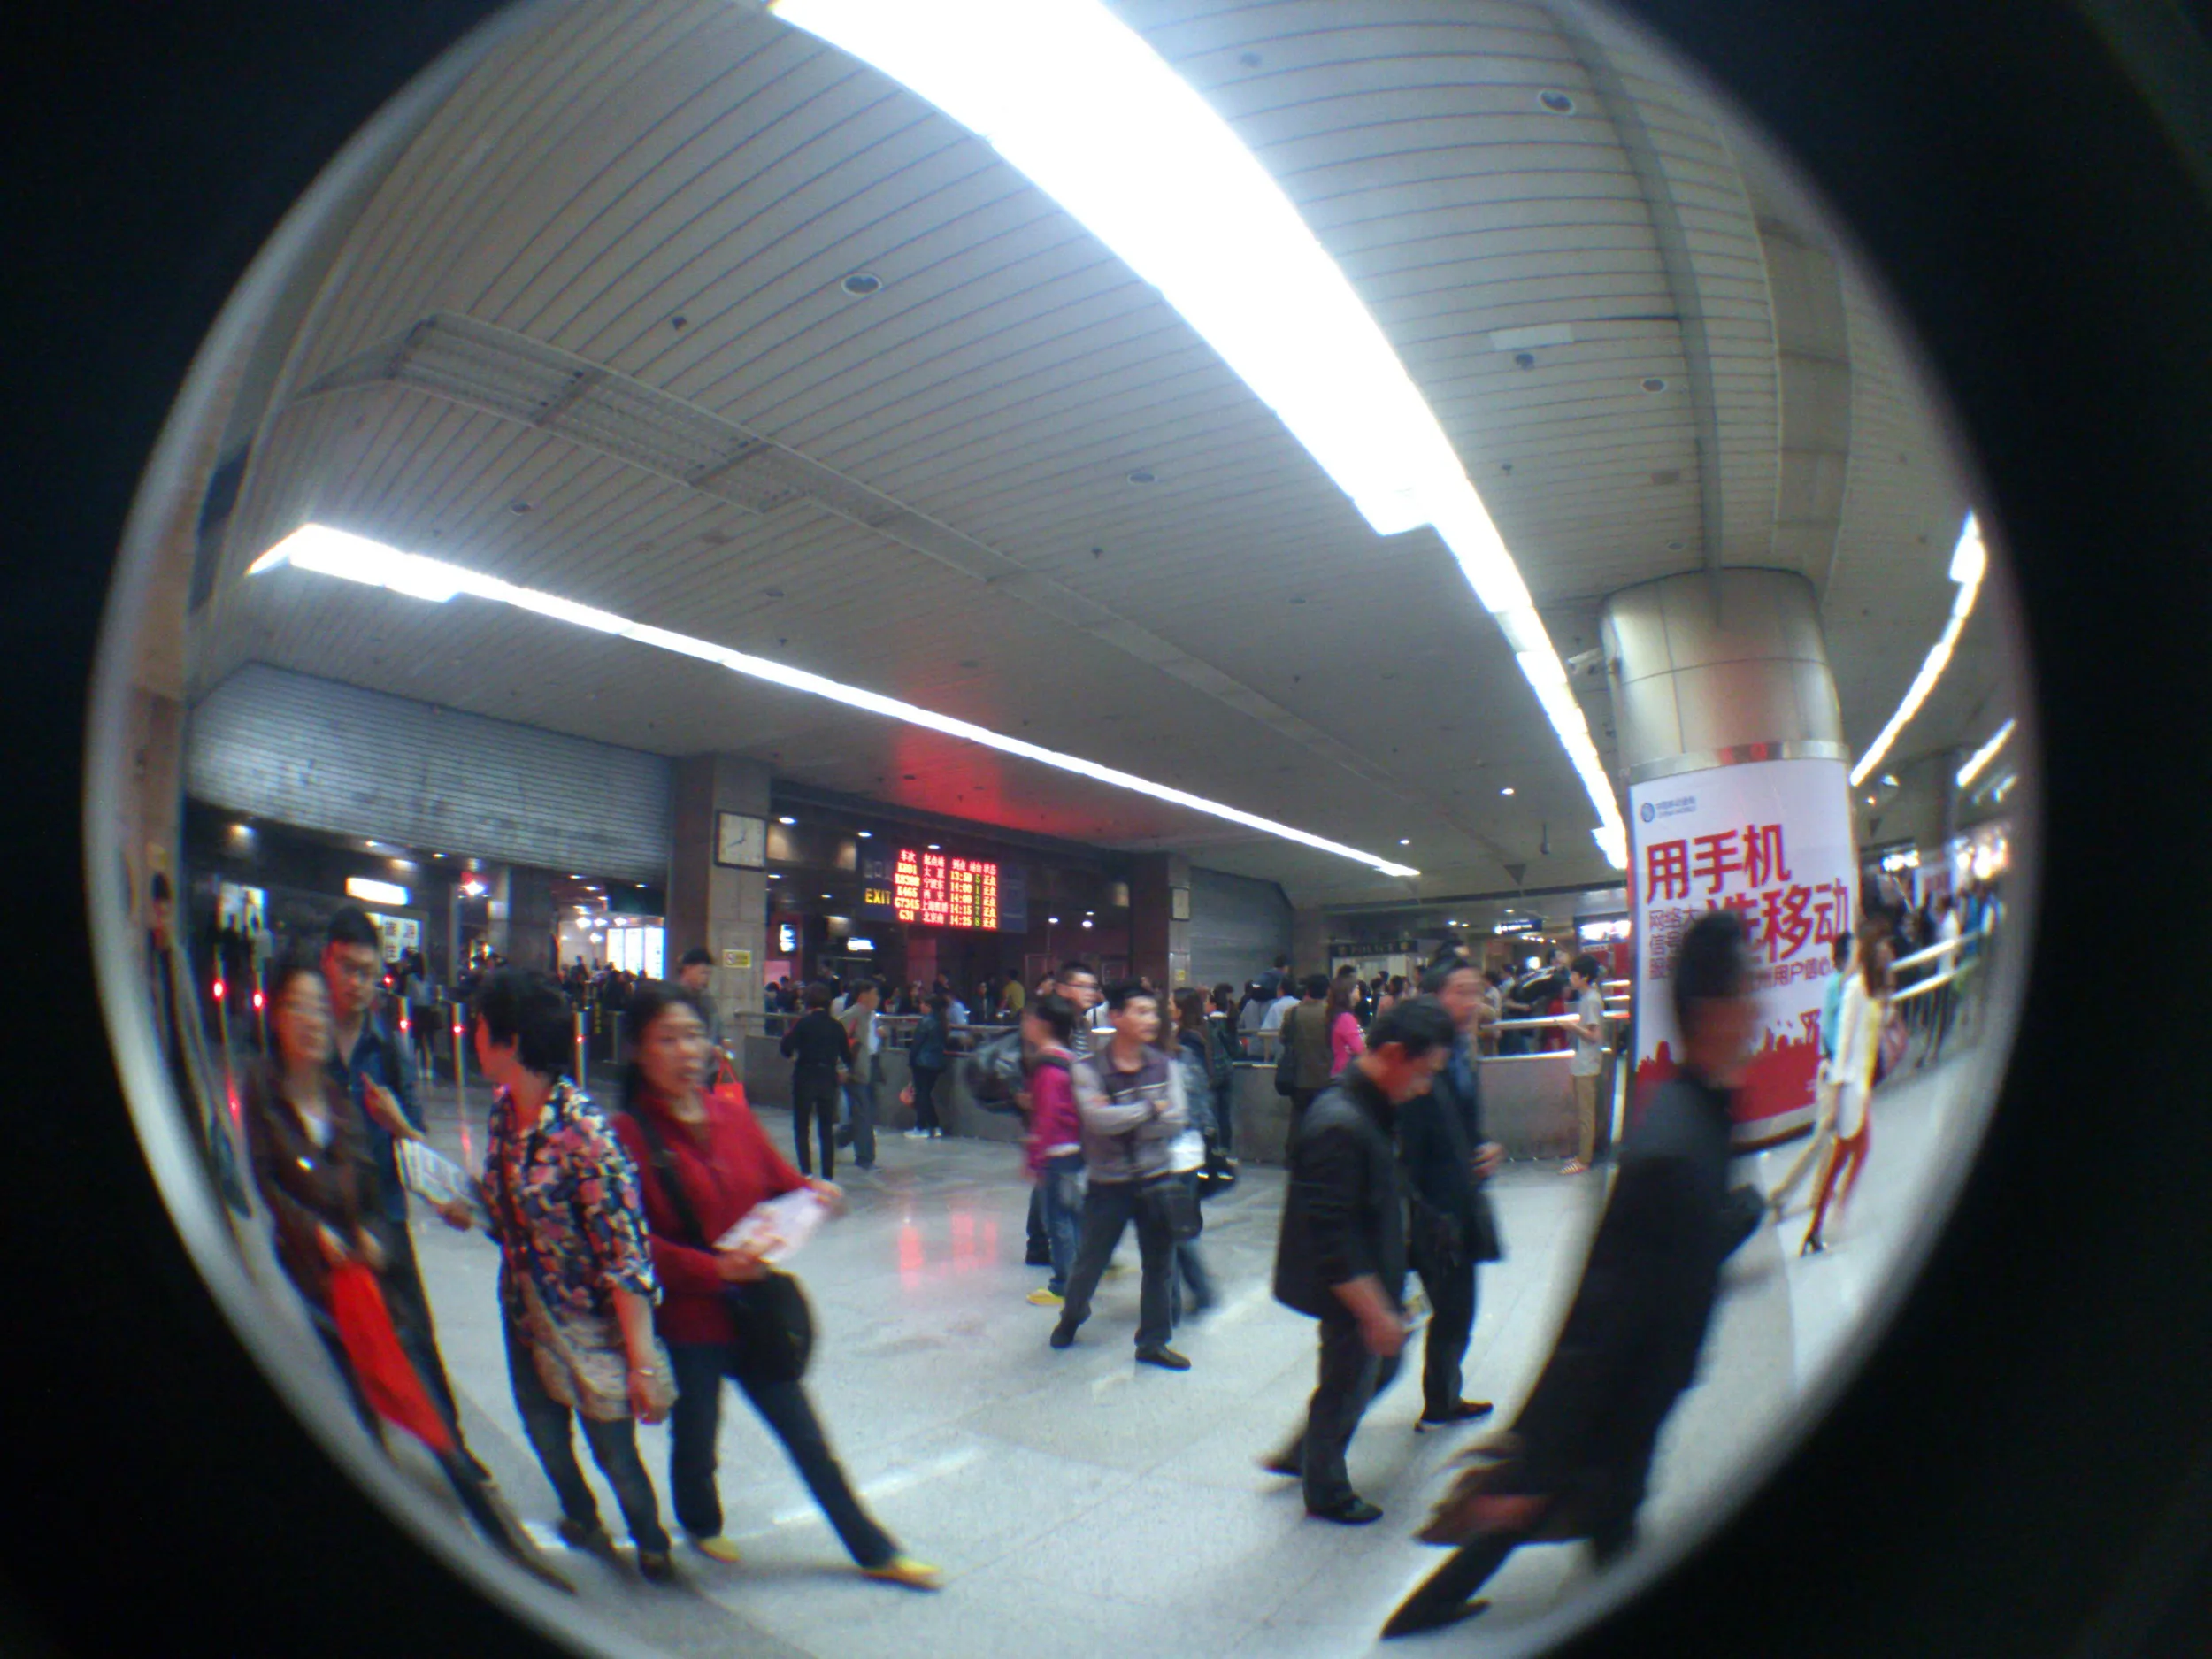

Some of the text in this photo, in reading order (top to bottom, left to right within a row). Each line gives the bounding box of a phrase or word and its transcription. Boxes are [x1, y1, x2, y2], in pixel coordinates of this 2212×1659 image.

[901, 849, 917, 864] 车次
[1646, 824, 1792, 904] 用手机
[983, 875, 996, 886] 正点
[865, 888, 891, 904] EXIT
[976, 885, 980, 894] 1
[983, 886, 996, 896] 正点
[983, 896, 996, 907] 正点
[950, 903, 972, 915] 14:15
[975, 906, 980, 916] 7
[983, 907, 996, 918] 正点
[899, 909, 914, 921] G31
[983, 918, 996, 929] 正点
